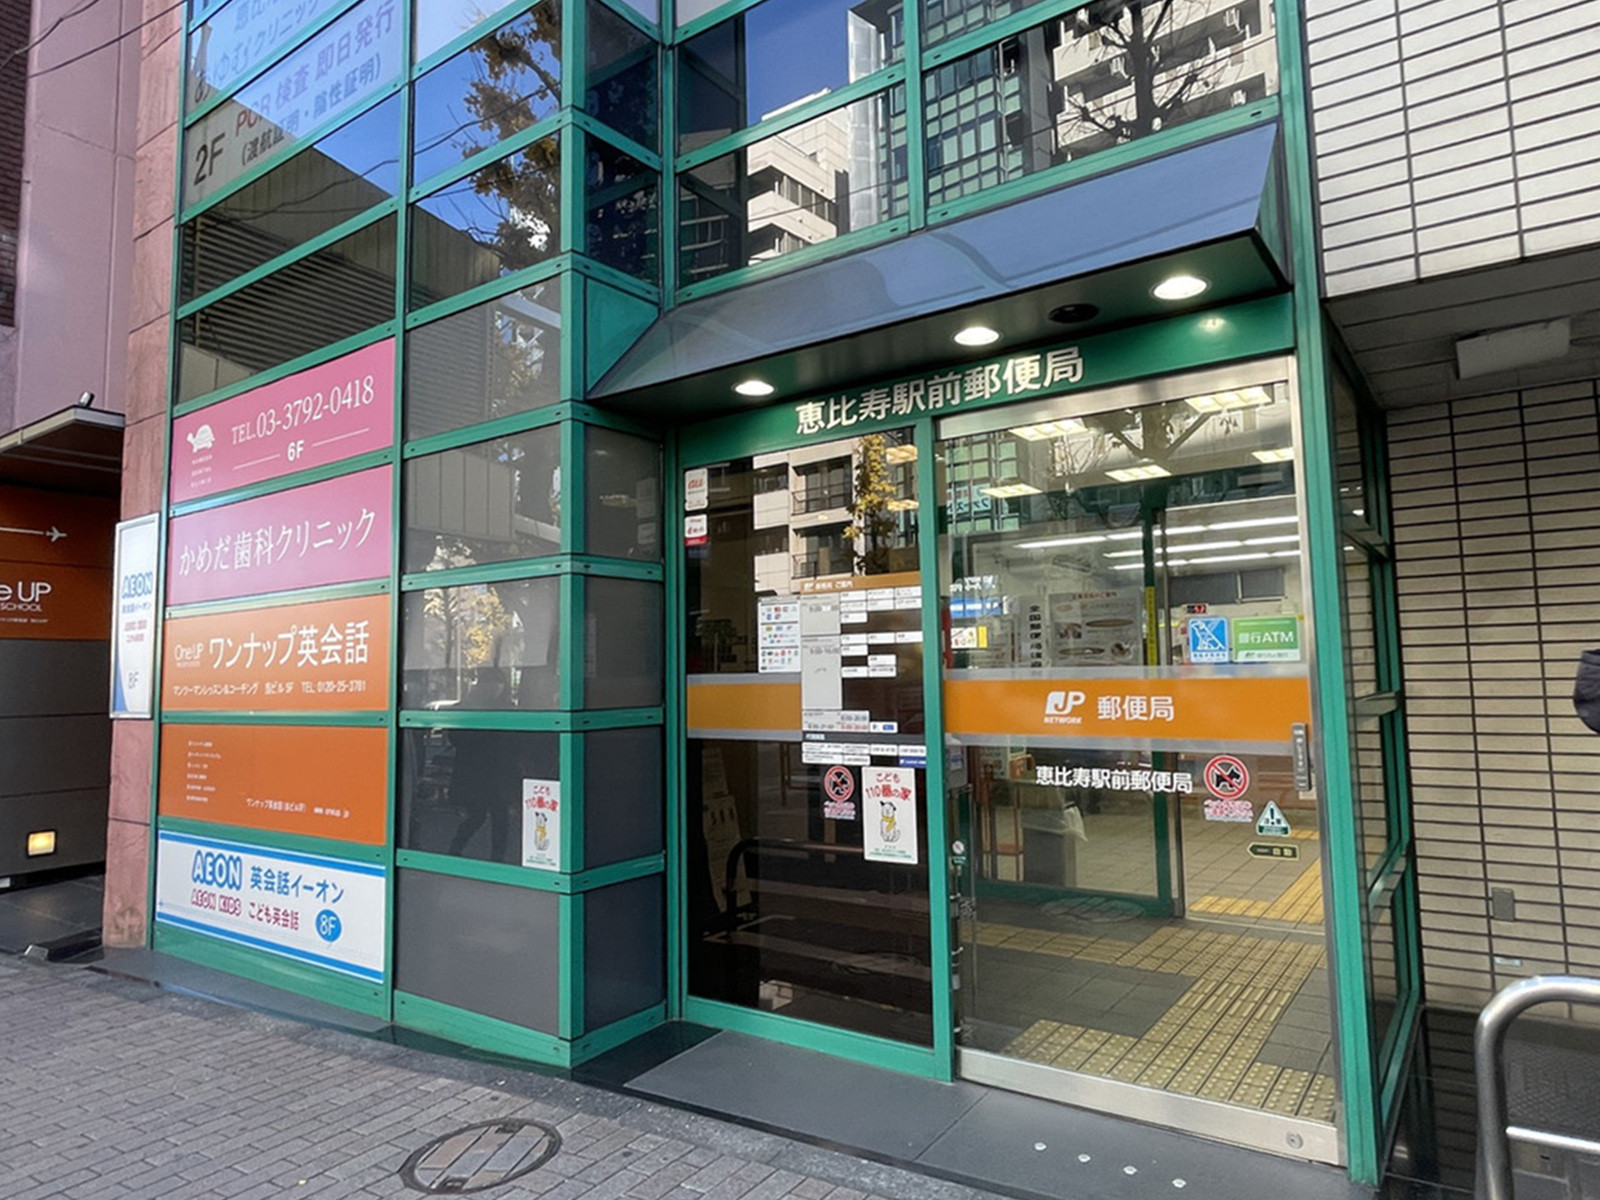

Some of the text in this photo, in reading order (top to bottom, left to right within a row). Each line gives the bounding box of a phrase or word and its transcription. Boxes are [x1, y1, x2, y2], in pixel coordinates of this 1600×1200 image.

[235, 1, 395, 136] PCR 検査 即日発行
[194, 133, 226, 186] 2F
[795, 346, 1084, 436] 恵比寿駅前郵便局
[287, 440, 305, 462] 6F
[179, 508, 375, 576] かめだ歯科クリニック
[18, 581, 52, 602] UP
[122, 572, 153, 599] AEON
[209, 620, 370, 669] ワンナップ英会話
[1097, 695, 1175, 722] 郵便局
[865, 783, 912, 801] 110番の家
[875, 772, 901, 783] こども
[1035, 764, 1194, 795] 恵比寿駅前郵便局
[191, 849, 345, 904] AEON 英会話イーオン
[191, 888, 300, 931] AEON KIDS こども英会話
[319, 913, 337, 936] 8F
